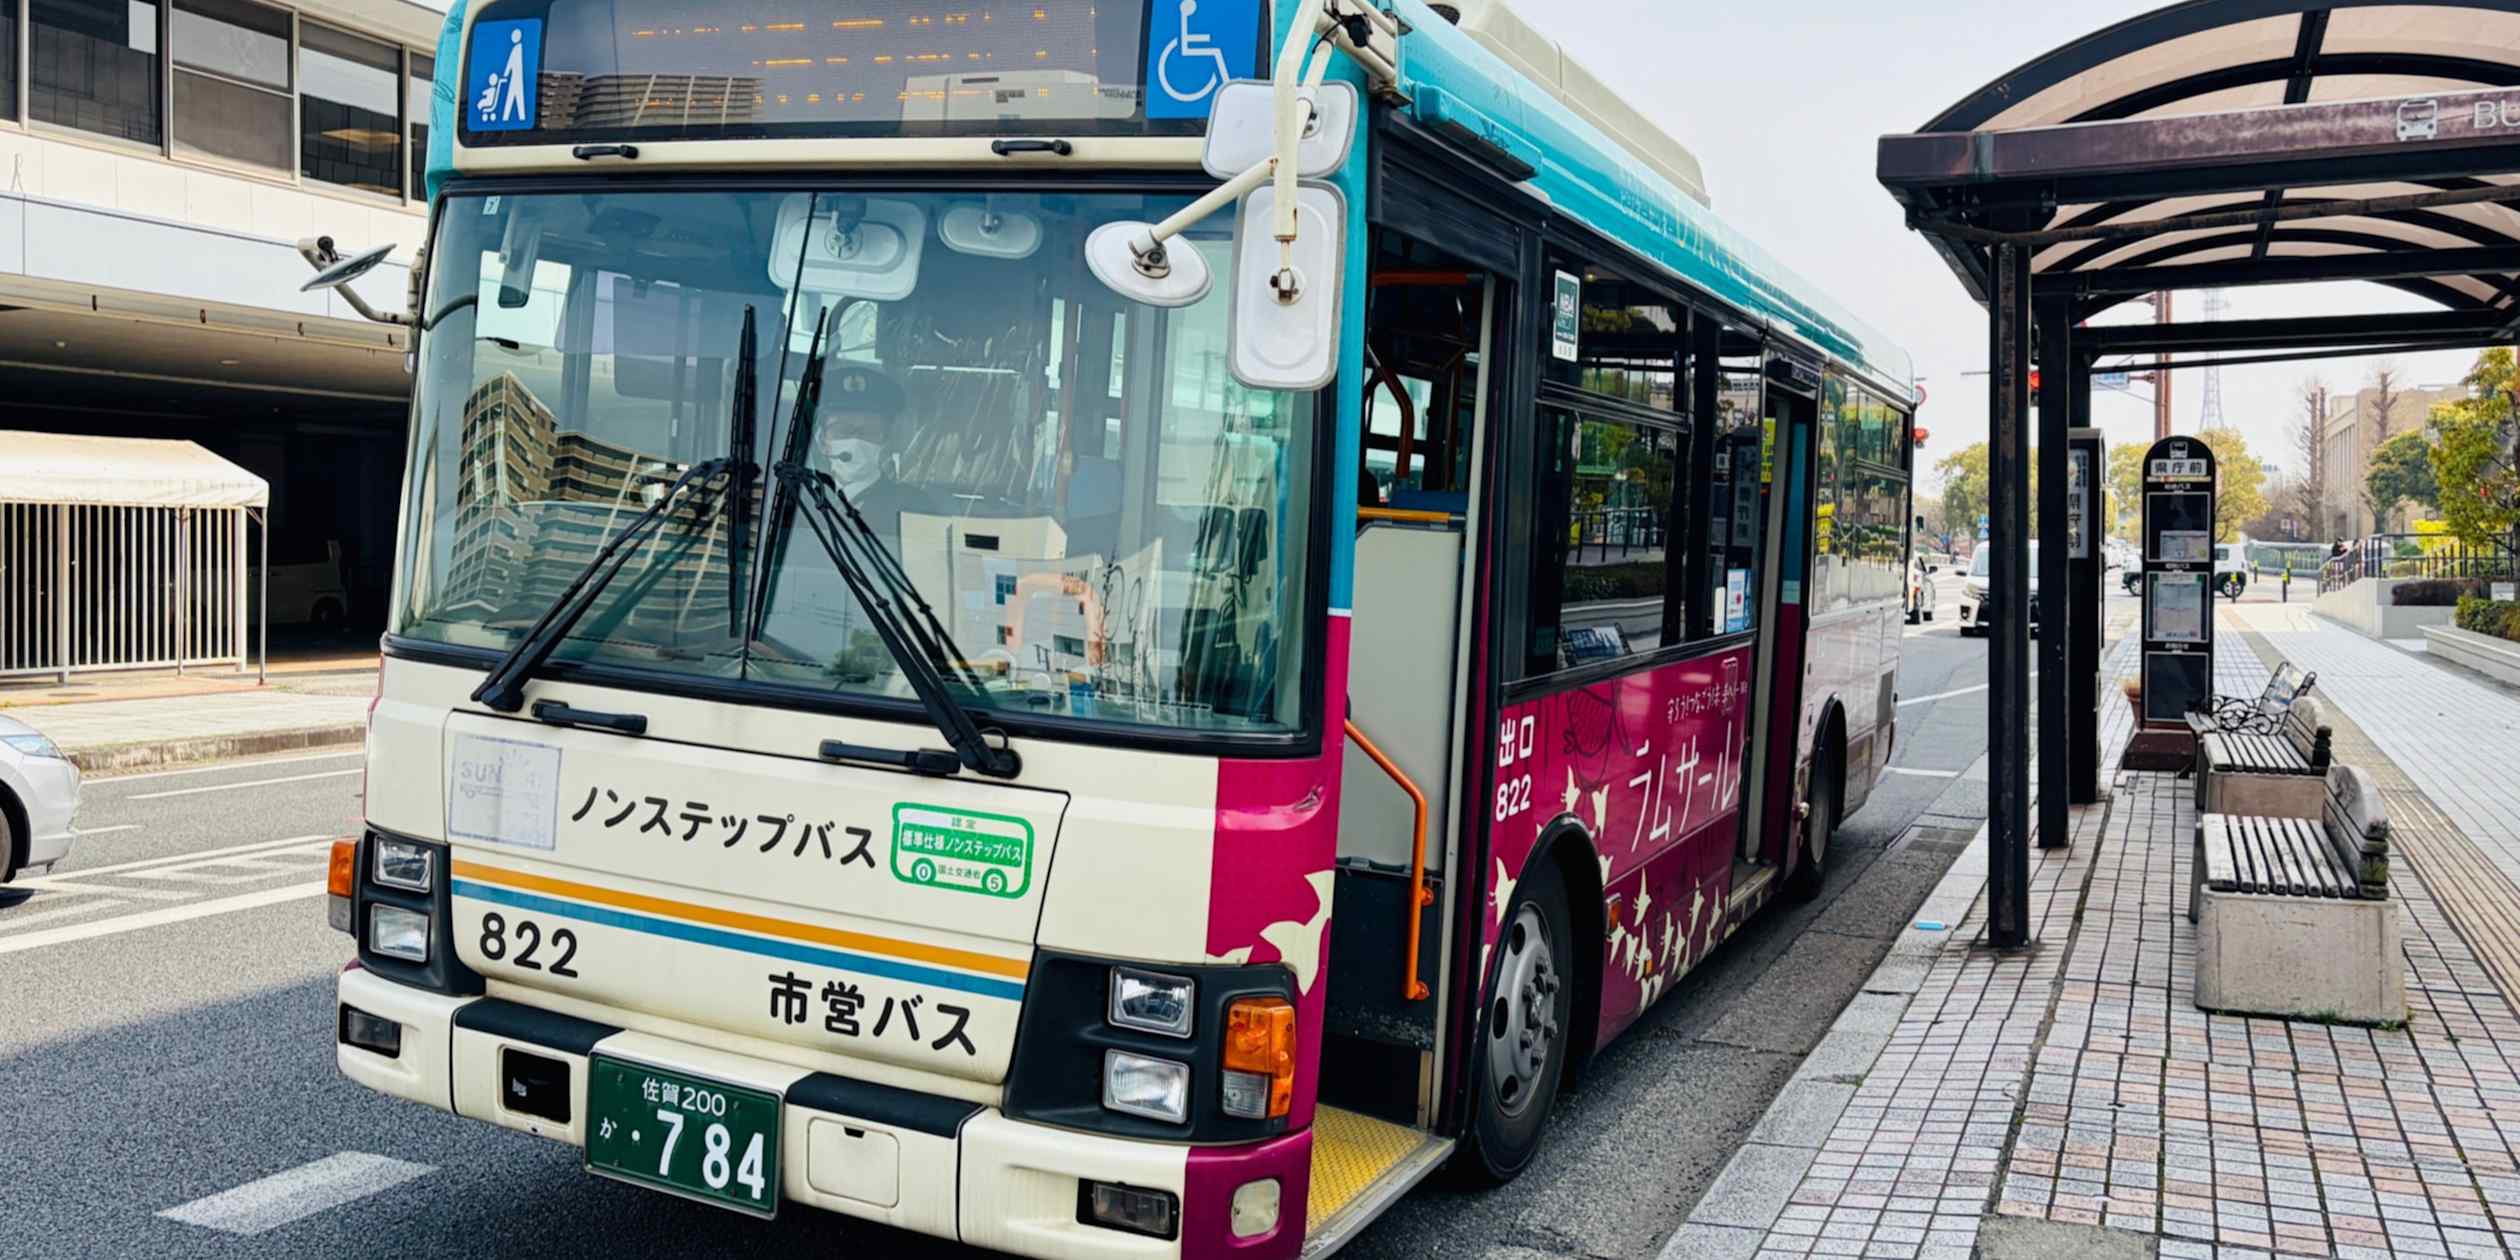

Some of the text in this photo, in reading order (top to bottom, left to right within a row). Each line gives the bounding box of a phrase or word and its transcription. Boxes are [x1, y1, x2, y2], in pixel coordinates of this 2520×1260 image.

[2154, 461, 2202, 475] 県庁前
[1498, 714, 1536, 768] 出口
[1495, 773, 1532, 823] 822
[1628, 719, 1736, 854] ラムサール
[571, 786, 877, 869] ノンステップバス
[989, 877, 1000, 891] 5
[479, 911, 579, 979] 822
[768, 971, 977, 1056] 市営バス
